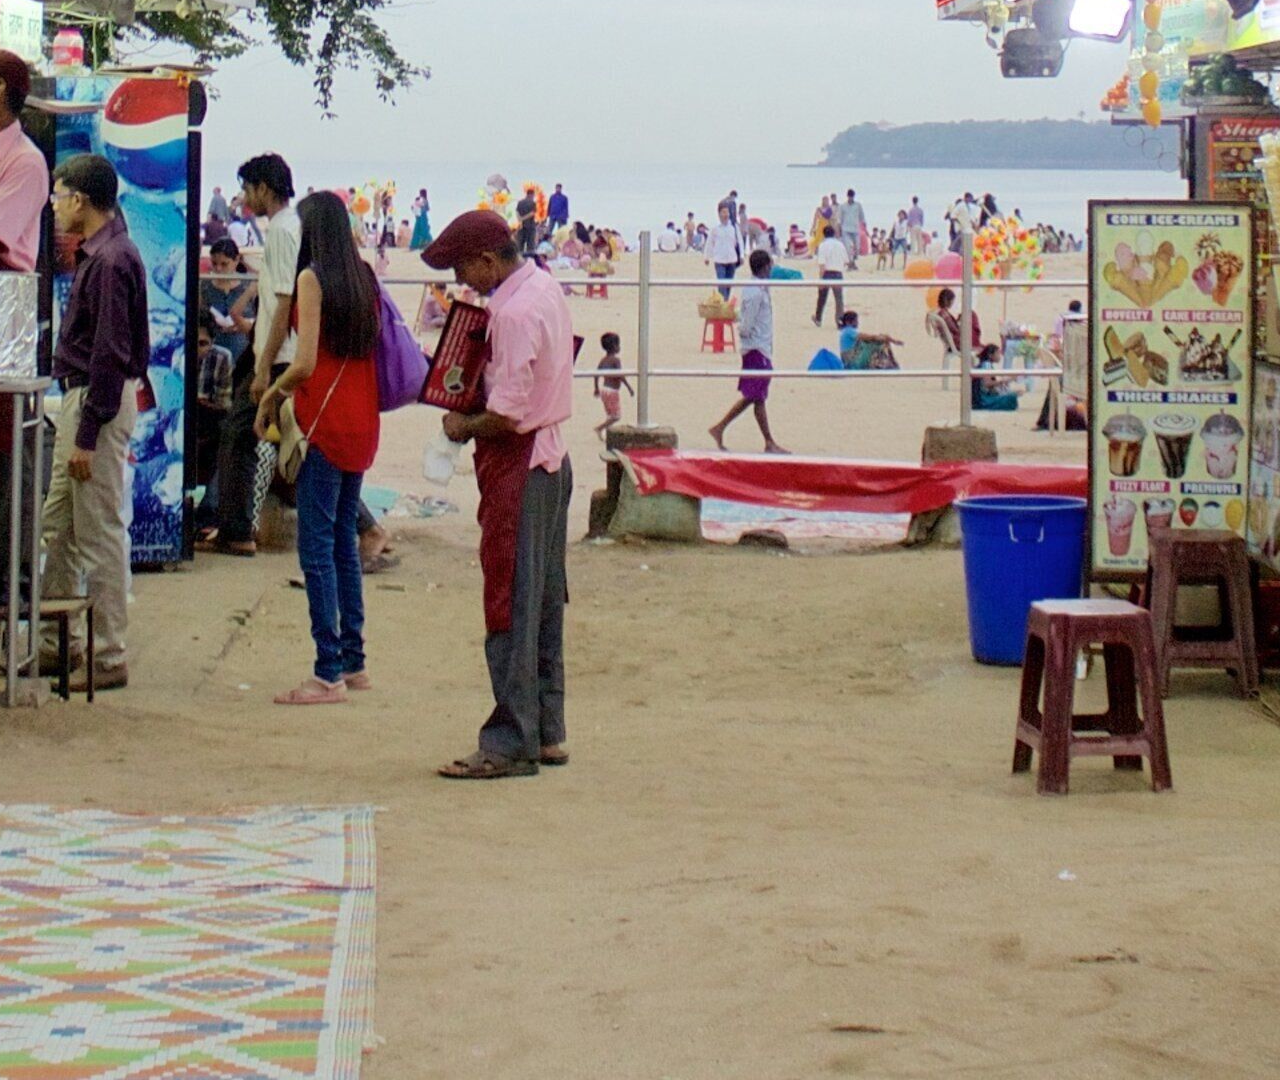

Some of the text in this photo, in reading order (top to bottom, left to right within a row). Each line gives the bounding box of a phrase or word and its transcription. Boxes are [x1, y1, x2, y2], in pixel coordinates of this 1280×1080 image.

[1110, 214, 1235, 226] CONE ICE-CREAMS
[1105, 310, 1150, 321] NOVELTY
[1115, 391, 1230, 404] THICK SHAKES
